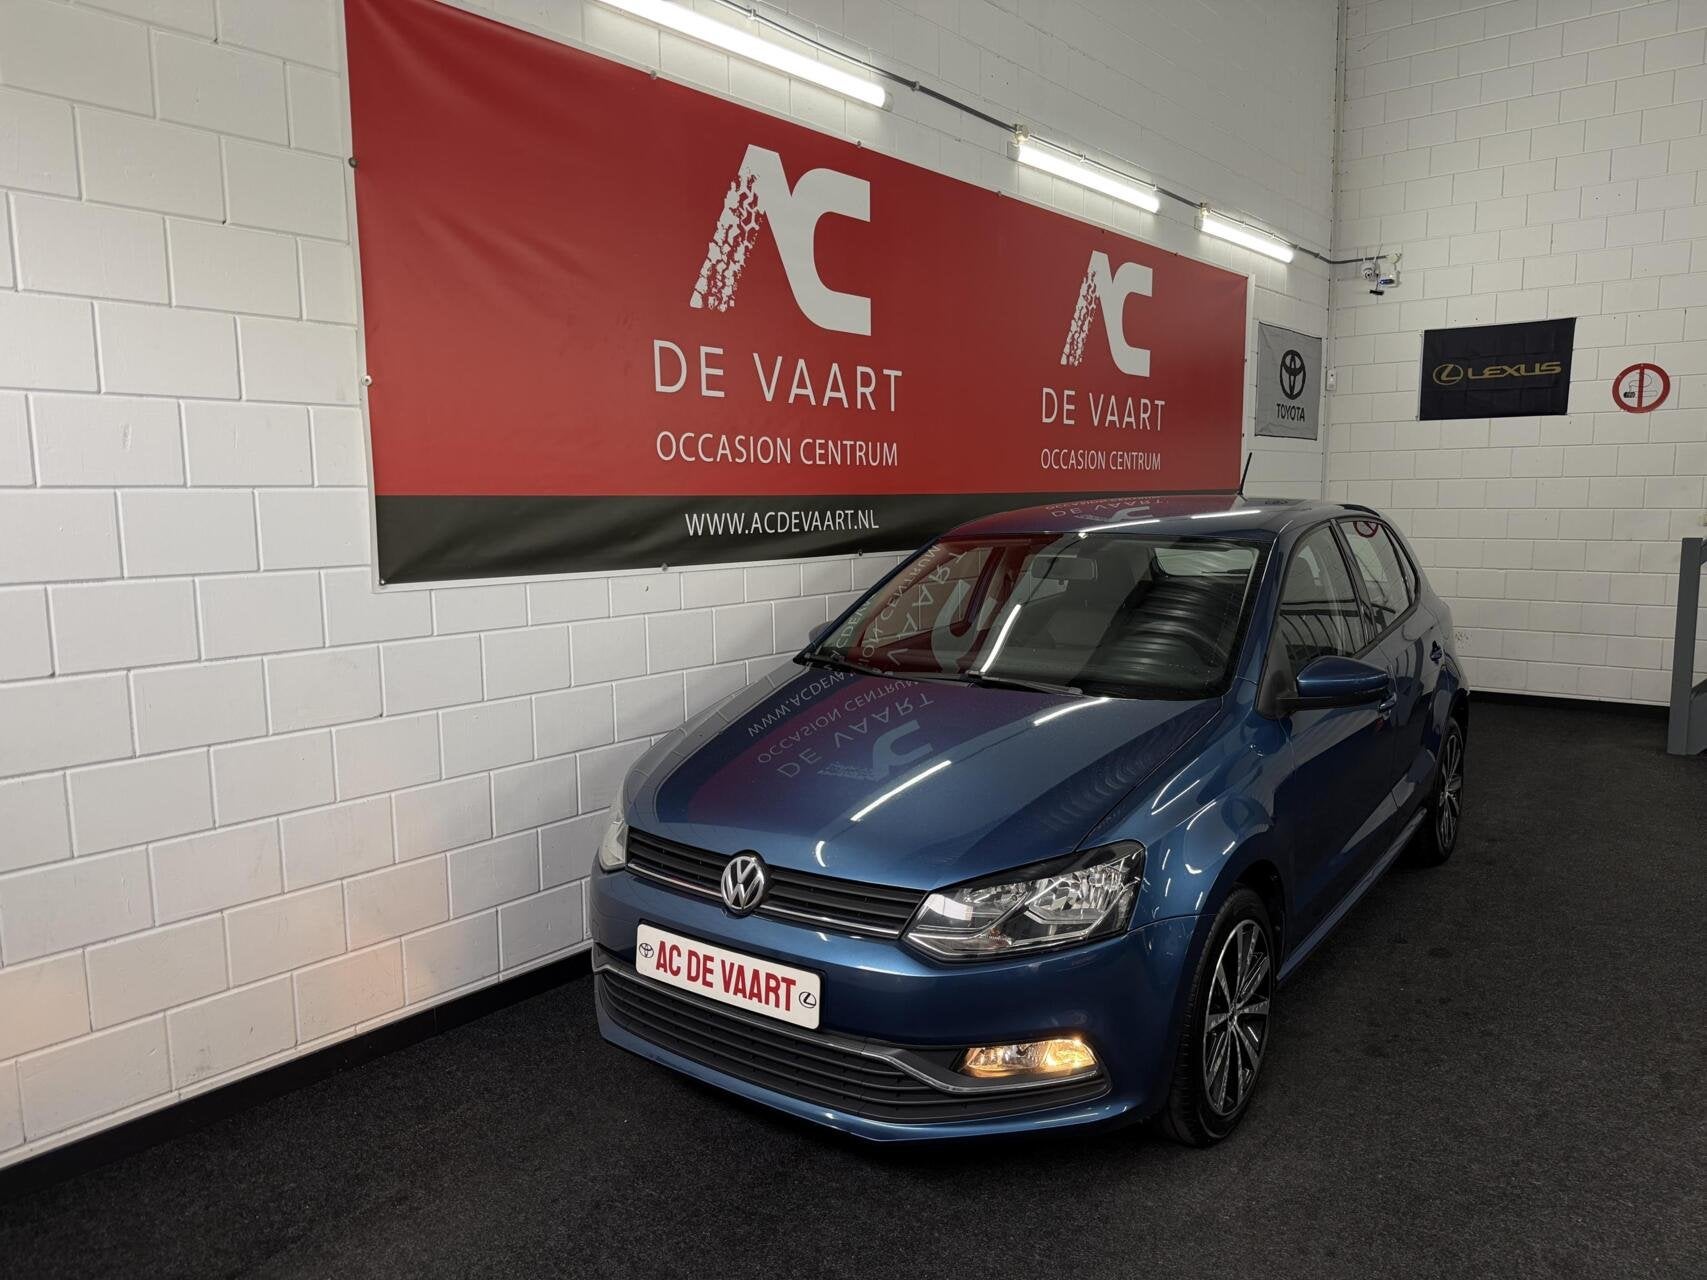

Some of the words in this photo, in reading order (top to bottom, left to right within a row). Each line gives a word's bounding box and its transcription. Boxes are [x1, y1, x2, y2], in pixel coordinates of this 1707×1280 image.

[653, 339, 726, 399] DE
[753, 352, 903, 412] VAART
[1467, 361, 1562, 380] LEXUS
[1041, 387, 1076, 425] DE
[1089, 392, 1166, 431] VAART
[1276, 403, 1305, 422] TOYOTA
[656, 431, 791, 464] OCCASION
[800, 438, 898, 466] CENTRUM
[1040, 448, 1106, 470] OCCASION
[1109, 451, 1161, 470] CENTRUM
[684, 509, 880, 537] WWW.ACDEVAART.NL
[656, 940, 682, 977] AC
[686, 949, 715, 989] DE
[720, 959, 796, 1012] VAART
